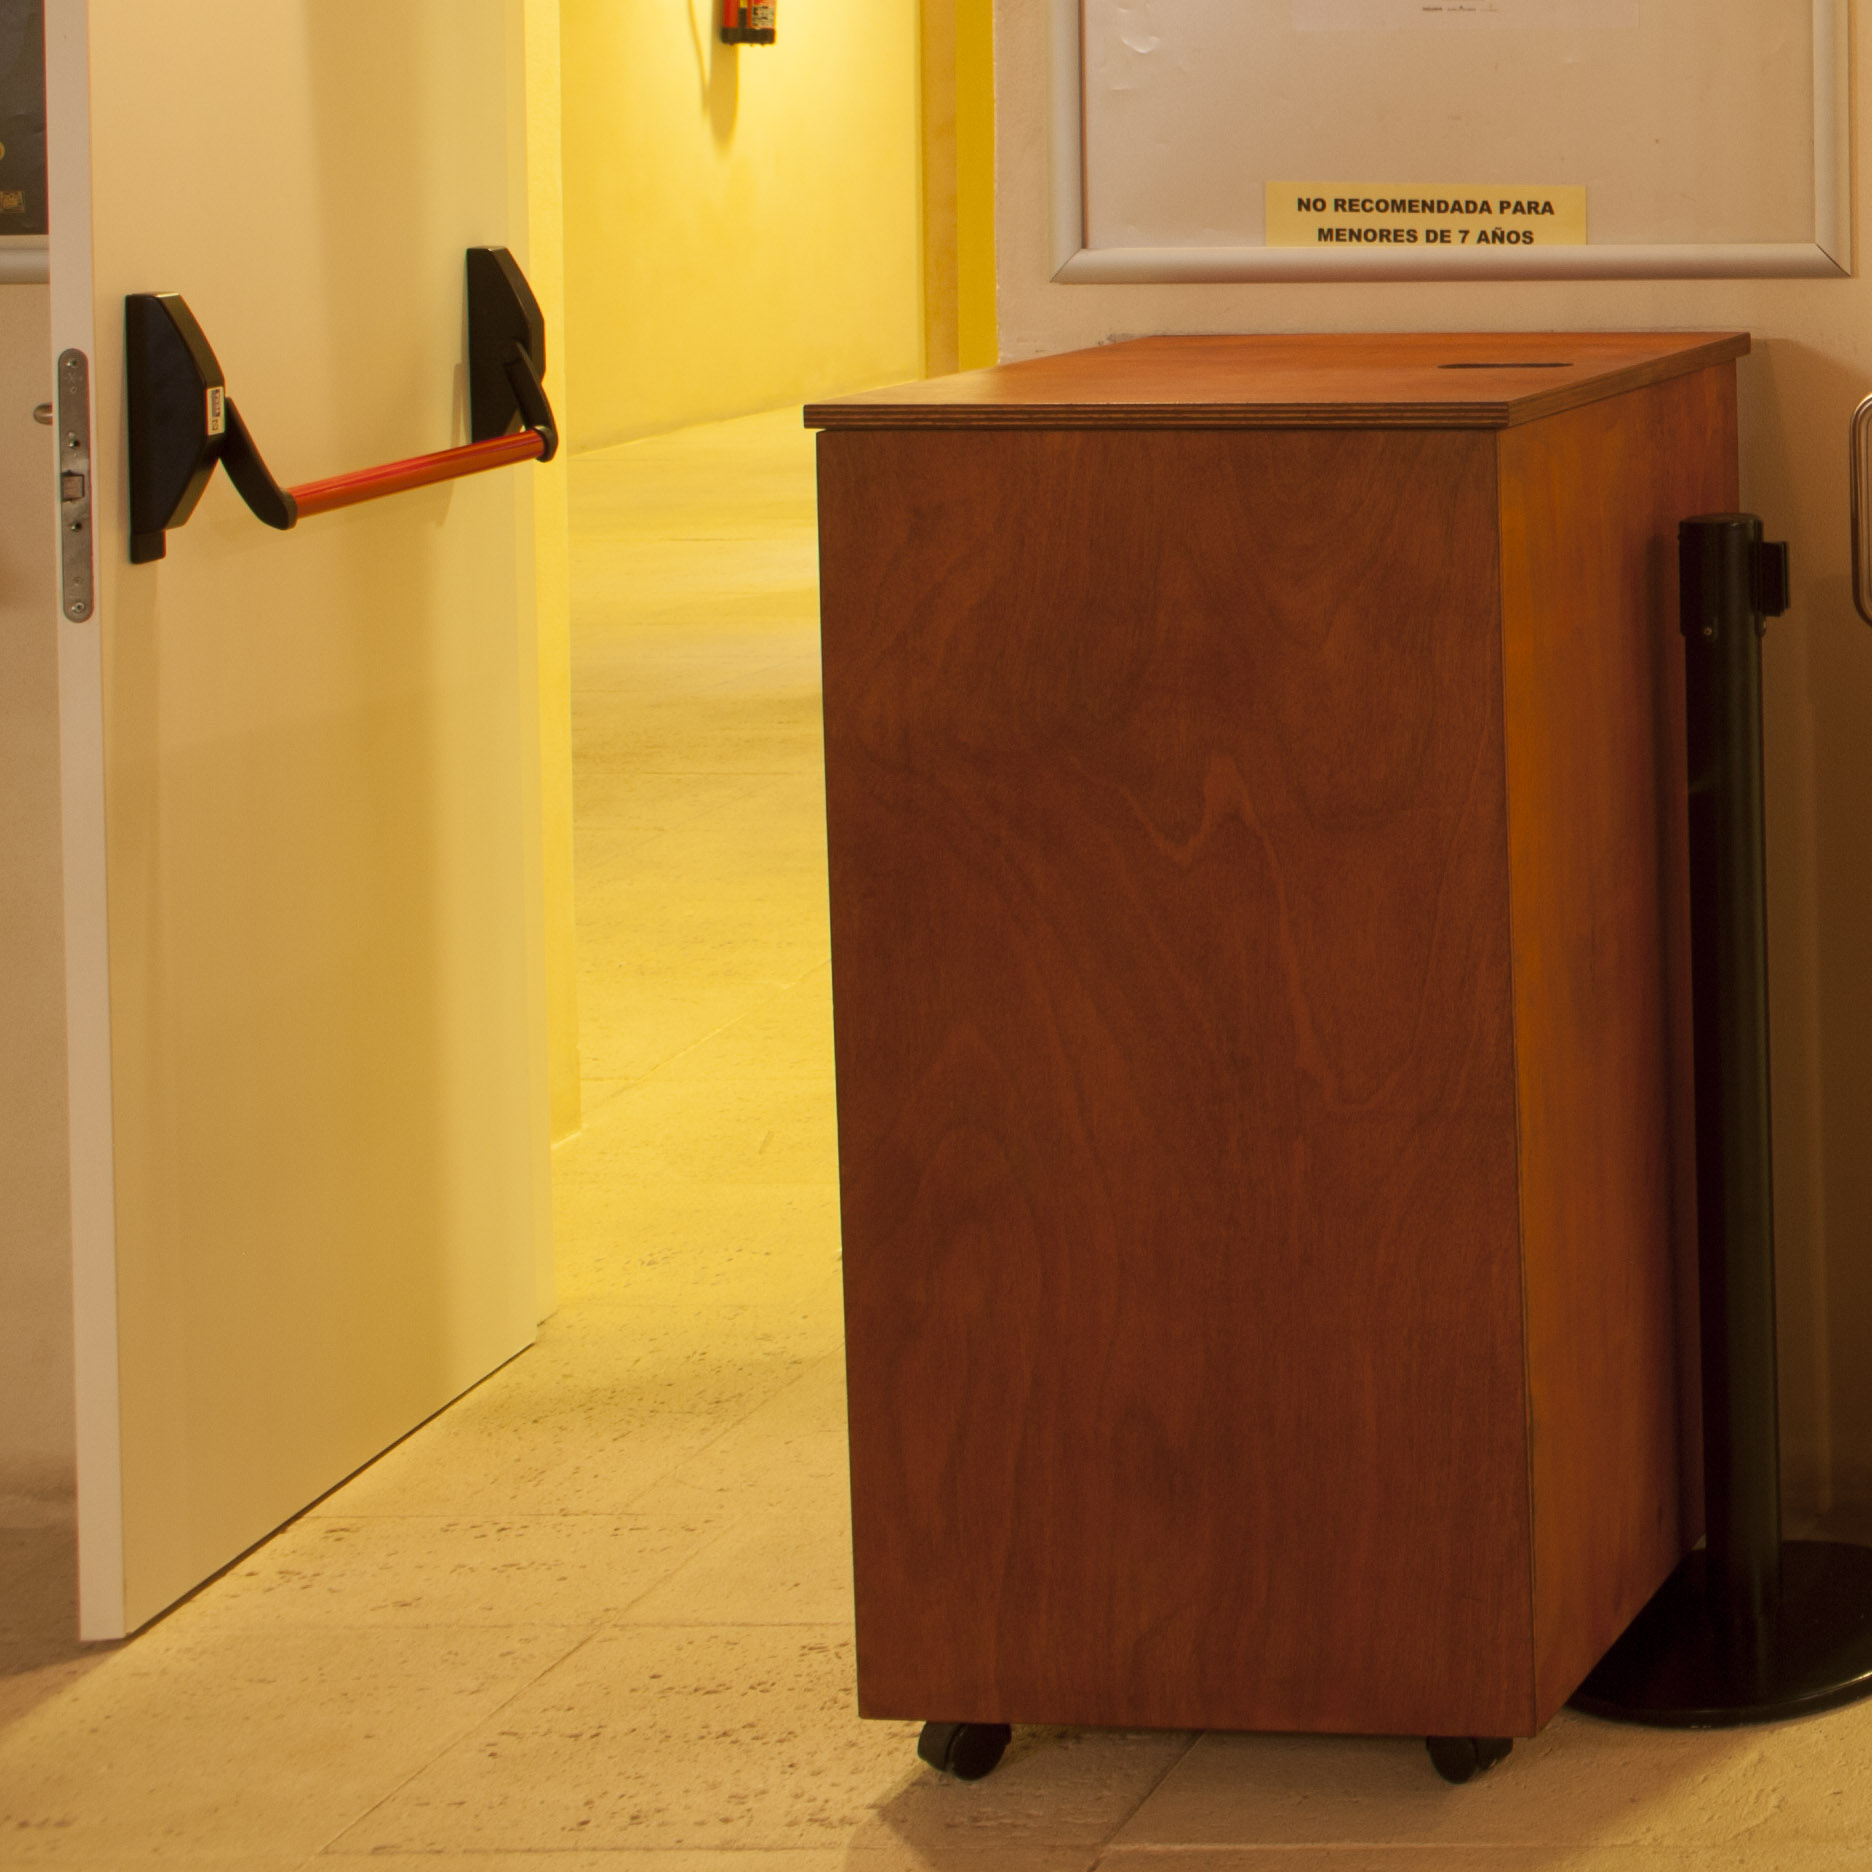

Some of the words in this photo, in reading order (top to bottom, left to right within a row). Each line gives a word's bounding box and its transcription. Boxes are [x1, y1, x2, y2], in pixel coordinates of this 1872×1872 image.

[1297, 197, 1327, 212] NO
[1333, 198, 1493, 215] RECOMENDADA
[1499, 200, 1555, 215] PARA
[1317, 228, 1418, 243] MENORES
[1425, 229, 1452, 244] DE
[1458, 229, 1471, 244] 7
[1476, 226, 1534, 245] AÑOS
